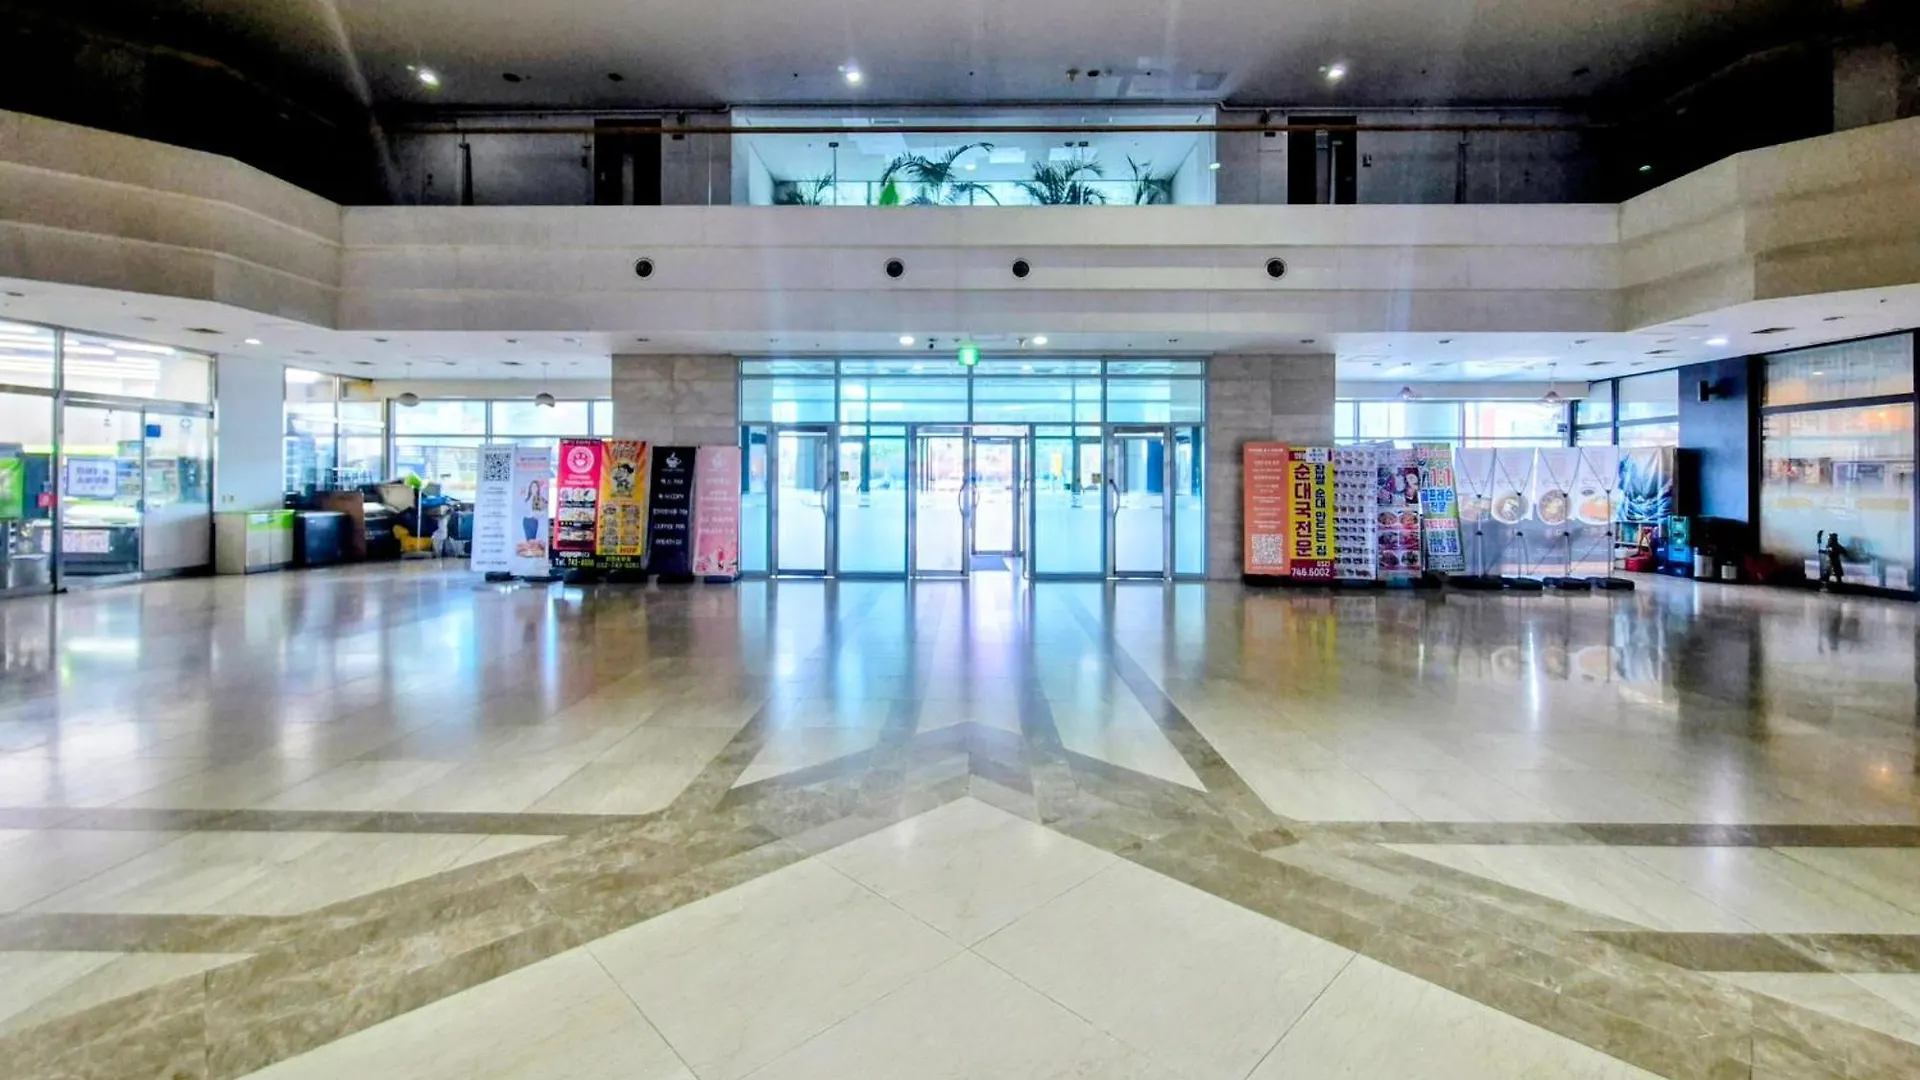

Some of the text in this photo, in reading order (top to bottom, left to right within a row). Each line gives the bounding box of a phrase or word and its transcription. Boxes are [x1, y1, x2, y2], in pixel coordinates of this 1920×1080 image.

[1431, 467, 1453, 487] 1:1
[1315, 488, 1326, 508] 순대
[1421, 488, 1453, 502] 골프레슨
[1294, 463, 1311, 557] 순대국전문
[1316, 545, 1327, 556] 집
